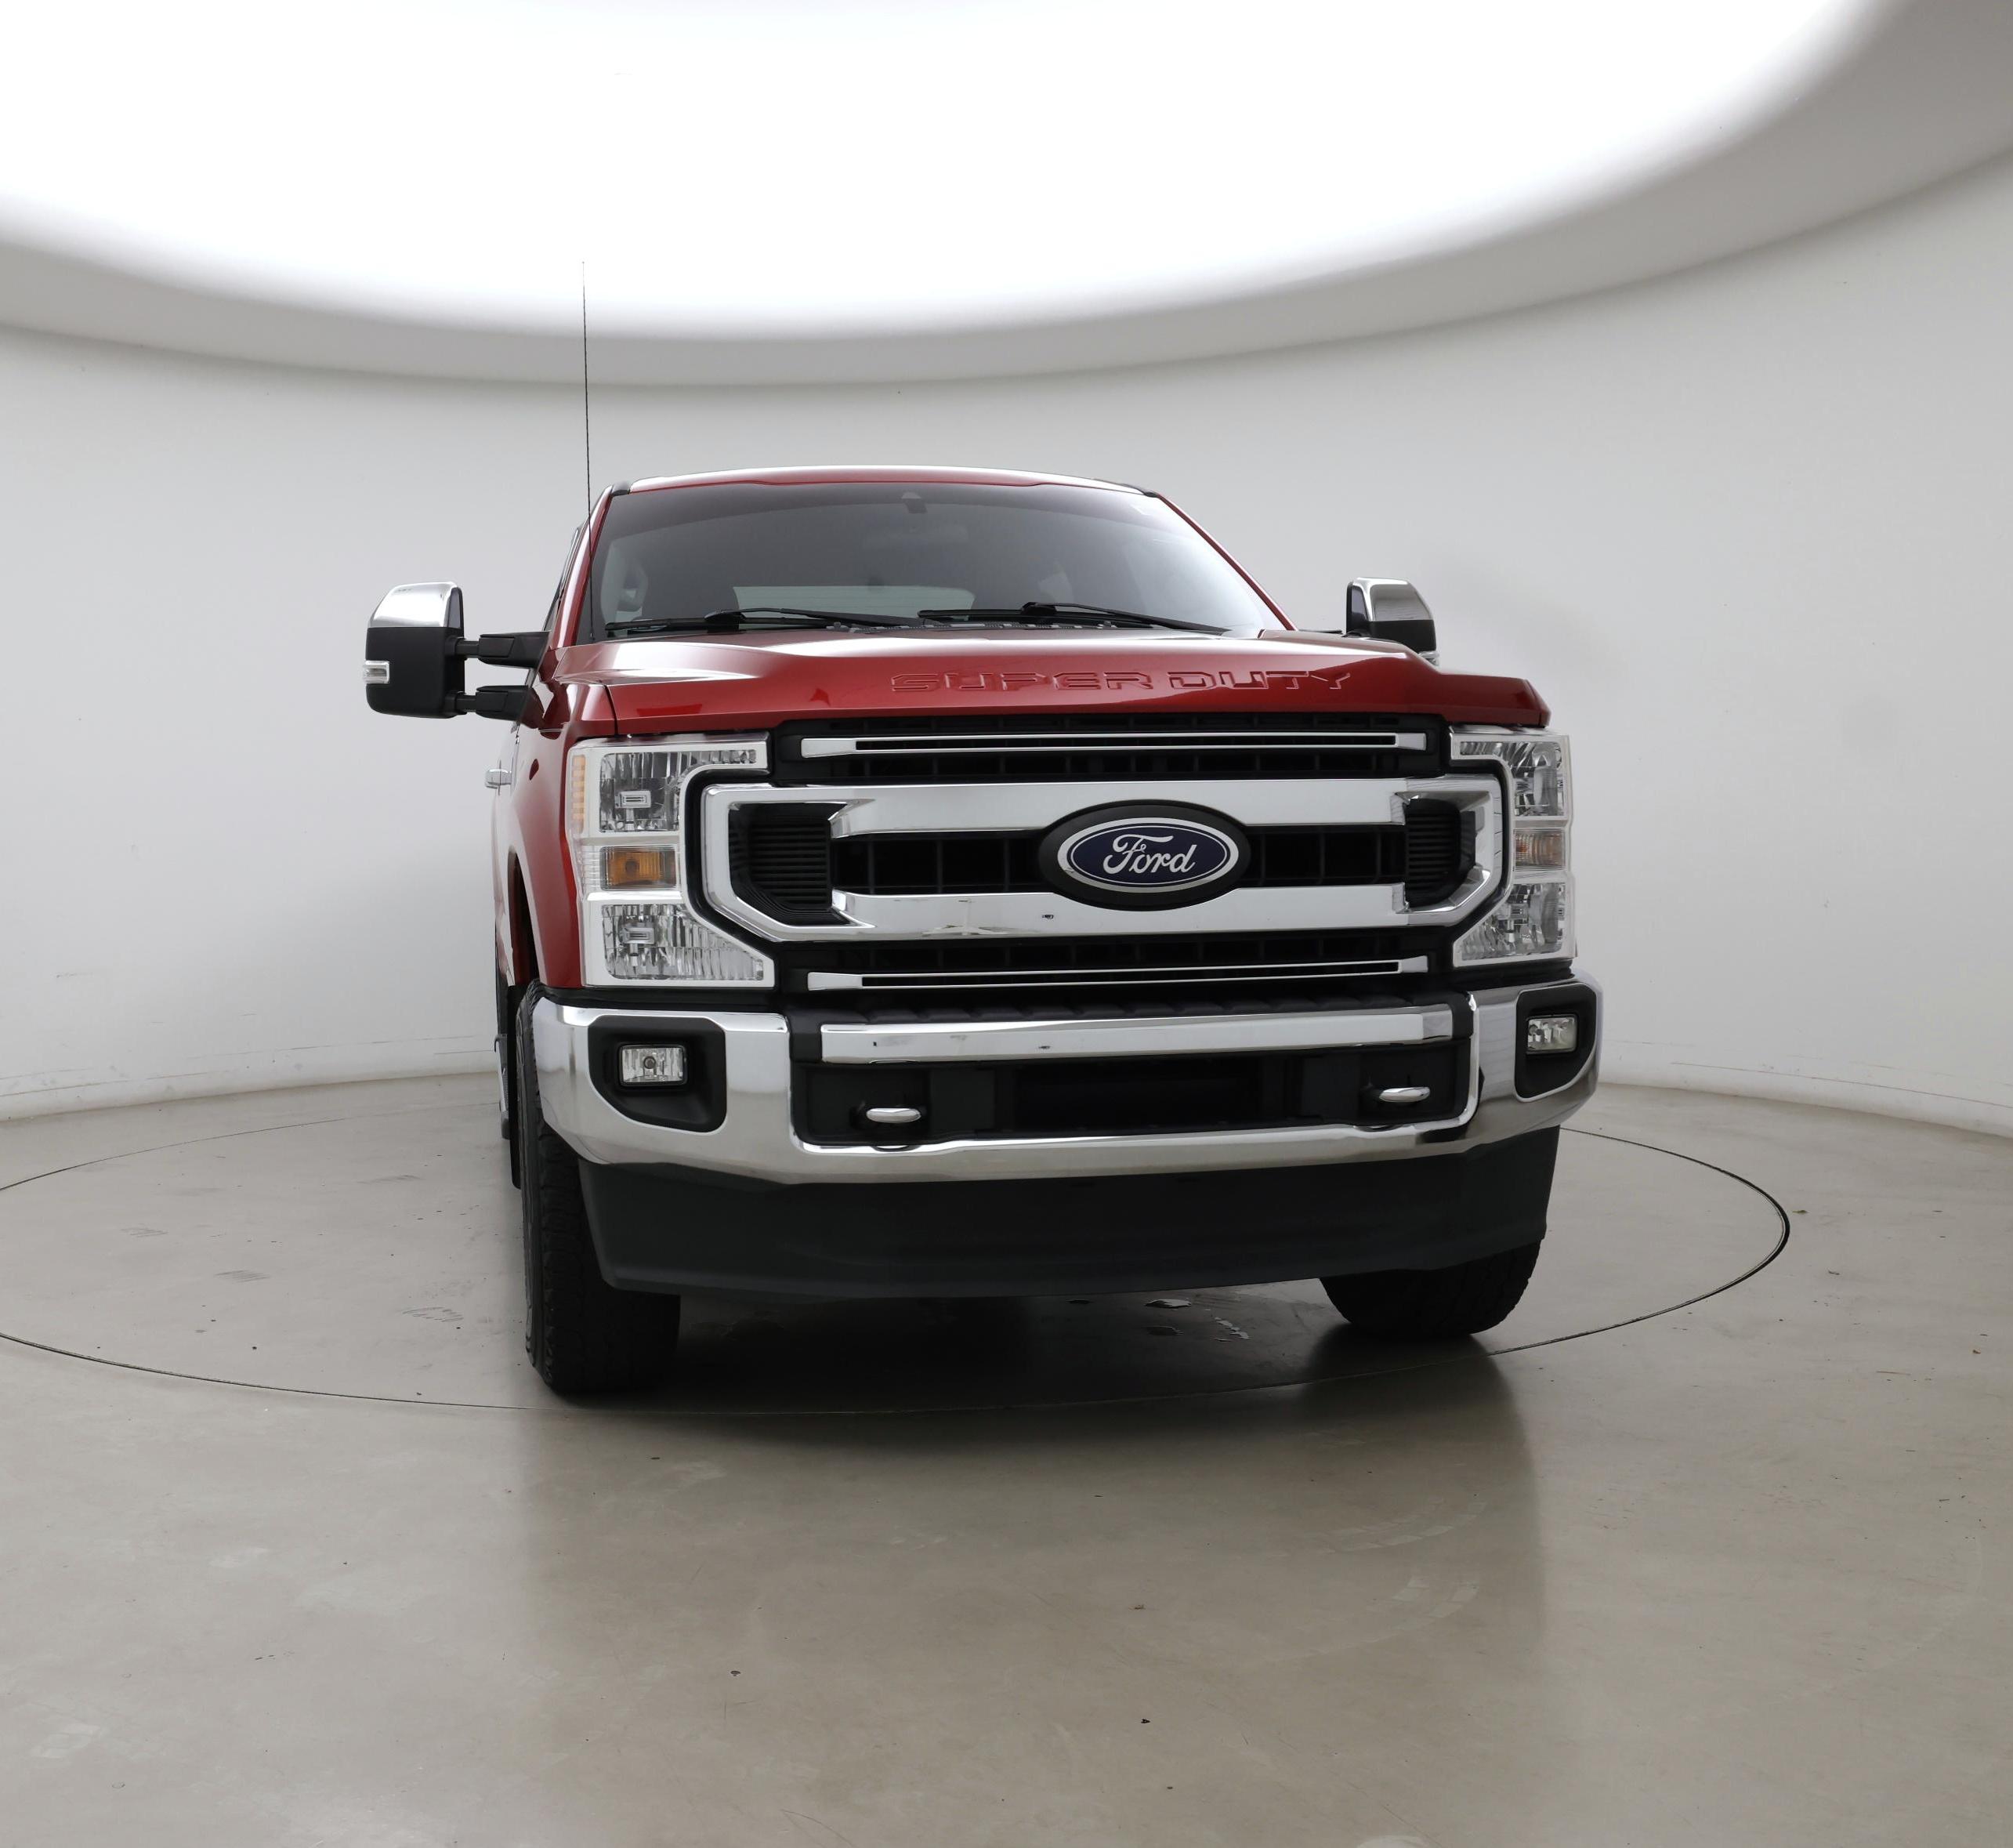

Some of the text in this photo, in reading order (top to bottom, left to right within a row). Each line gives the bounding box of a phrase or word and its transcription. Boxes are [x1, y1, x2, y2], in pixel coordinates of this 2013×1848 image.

[890, 670, 1352, 692] SUPER DUTY
[1102, 834, 1197, 875] Ford
